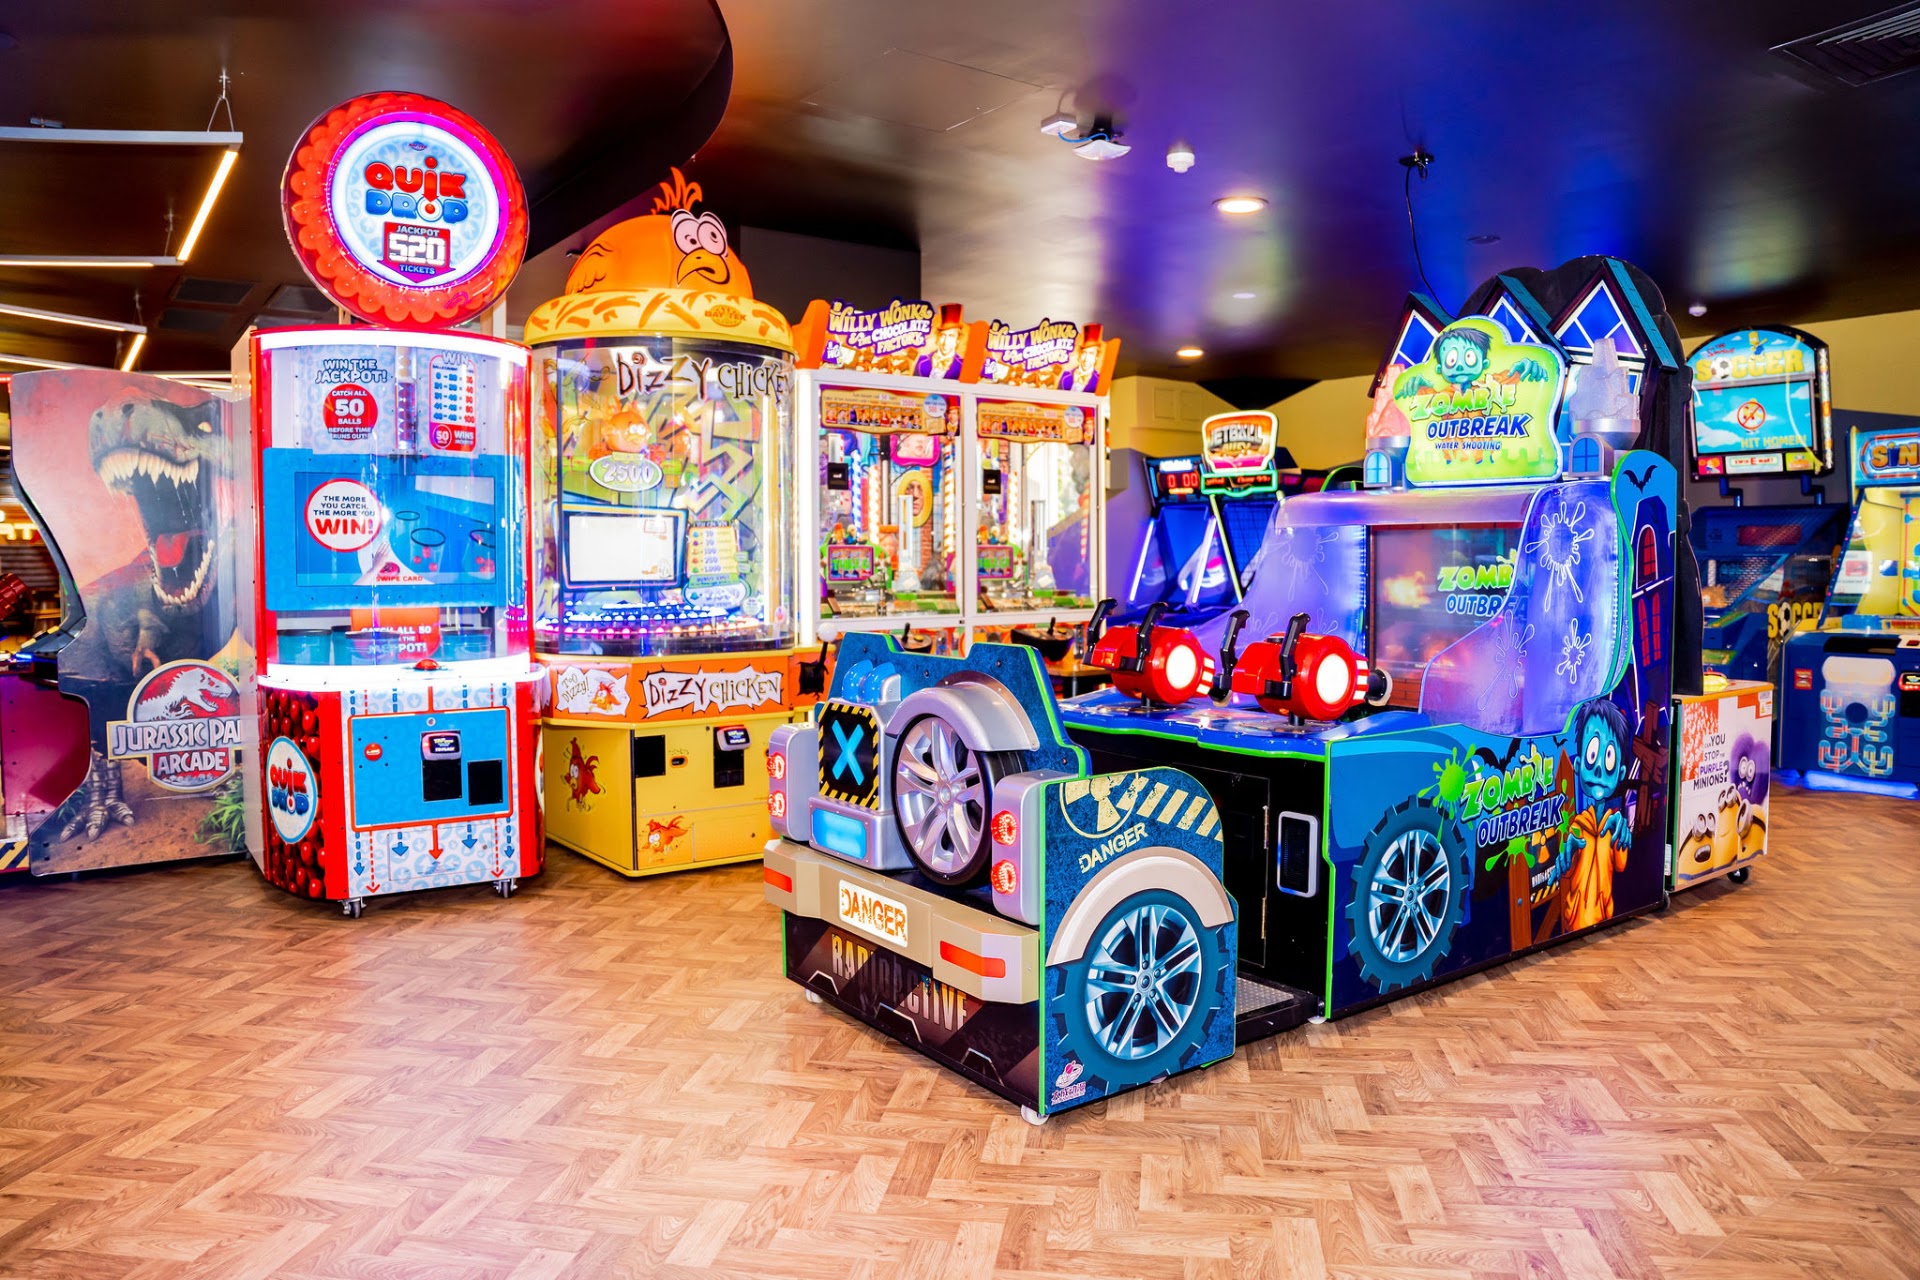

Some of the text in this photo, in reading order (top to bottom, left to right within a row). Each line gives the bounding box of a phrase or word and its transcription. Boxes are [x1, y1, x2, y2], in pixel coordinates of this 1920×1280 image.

[366, 189, 468, 224] DROP
[396, 225, 440, 237] JACKPOT
[388, 233, 446, 266] 520
[399, 264, 436, 275] TICKETS
[728, 312, 747, 321] TEK
[829, 299, 933, 333] WILLY WONKA
[872, 320, 930, 342] CHOCOLATE
[987, 320, 1077, 350] WILLY WONKA
[877, 332, 925, 354] FACTORY
[323, 358, 378, 371] WIN THE
[442, 350, 470, 366] WIN
[1696, 349, 1804, 382] SOCCER
[315, 369, 388, 384] JACKPOT!
[334, 398, 365, 417] 50
[1426, 412, 1533, 440] OUTBREAK
[1435, 441, 1502, 451] WATER SHOOTING
[1741, 437, 1760, 449] HIT
[601, 459, 654, 484] 2500
[315, 518, 374, 535] WIN!
[1437, 549, 1519, 592] ZOMB
[397, 625, 416, 634] ALL
[418, 625, 432, 634] 50
[112, 717, 241, 756] JURASSIC PA
[1710, 733, 1726, 748] YOU
[156, 750, 227, 777] ARCADE
[1704, 749, 1720, 762] STOP
[1693, 760, 1730, 791] MINIONS?
[1699, 760, 1723, 776] PURPLE
[271, 787, 310, 816] DROP
[1477, 792, 1566, 848] OUTBREAK
[1078, 822, 1149, 874] DANGER
[841, 887, 908, 942] DANGER
